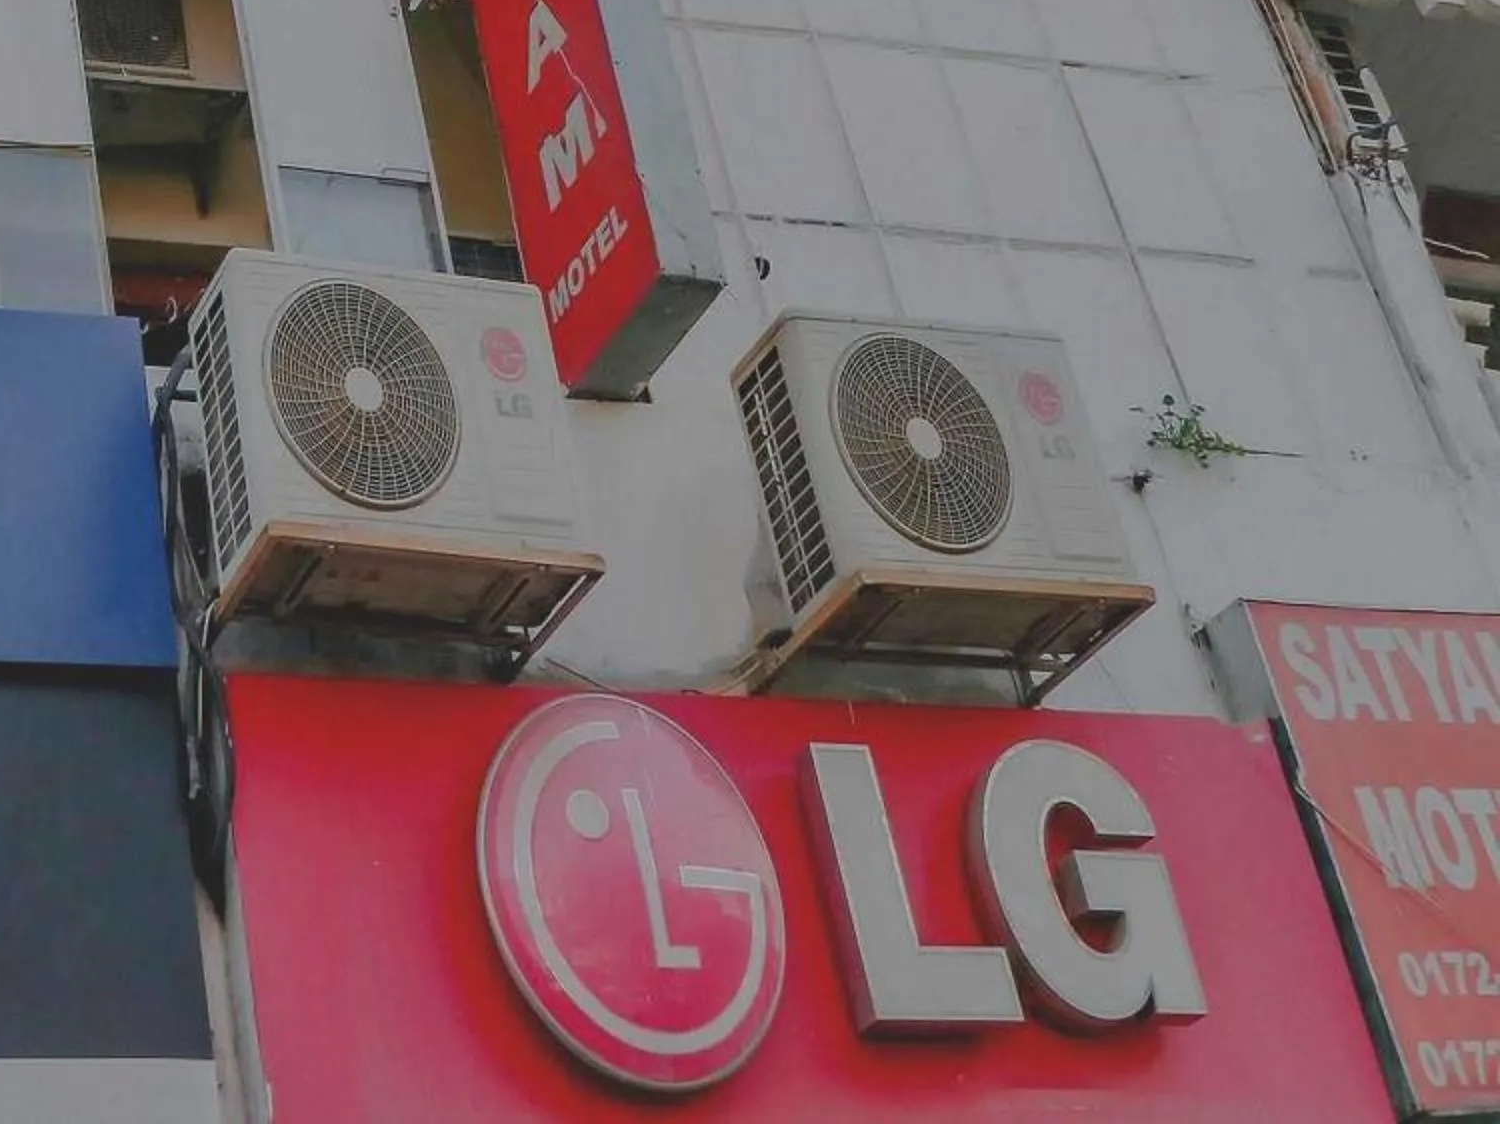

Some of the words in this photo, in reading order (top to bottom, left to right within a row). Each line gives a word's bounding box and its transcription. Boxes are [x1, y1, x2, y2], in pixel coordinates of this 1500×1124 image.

[547, 204, 629, 324] MOTEL
[494, 389, 534, 419] LG
[805, 738, 1208, 1034] LG
[1355, 786, 1500, 890] MOT
